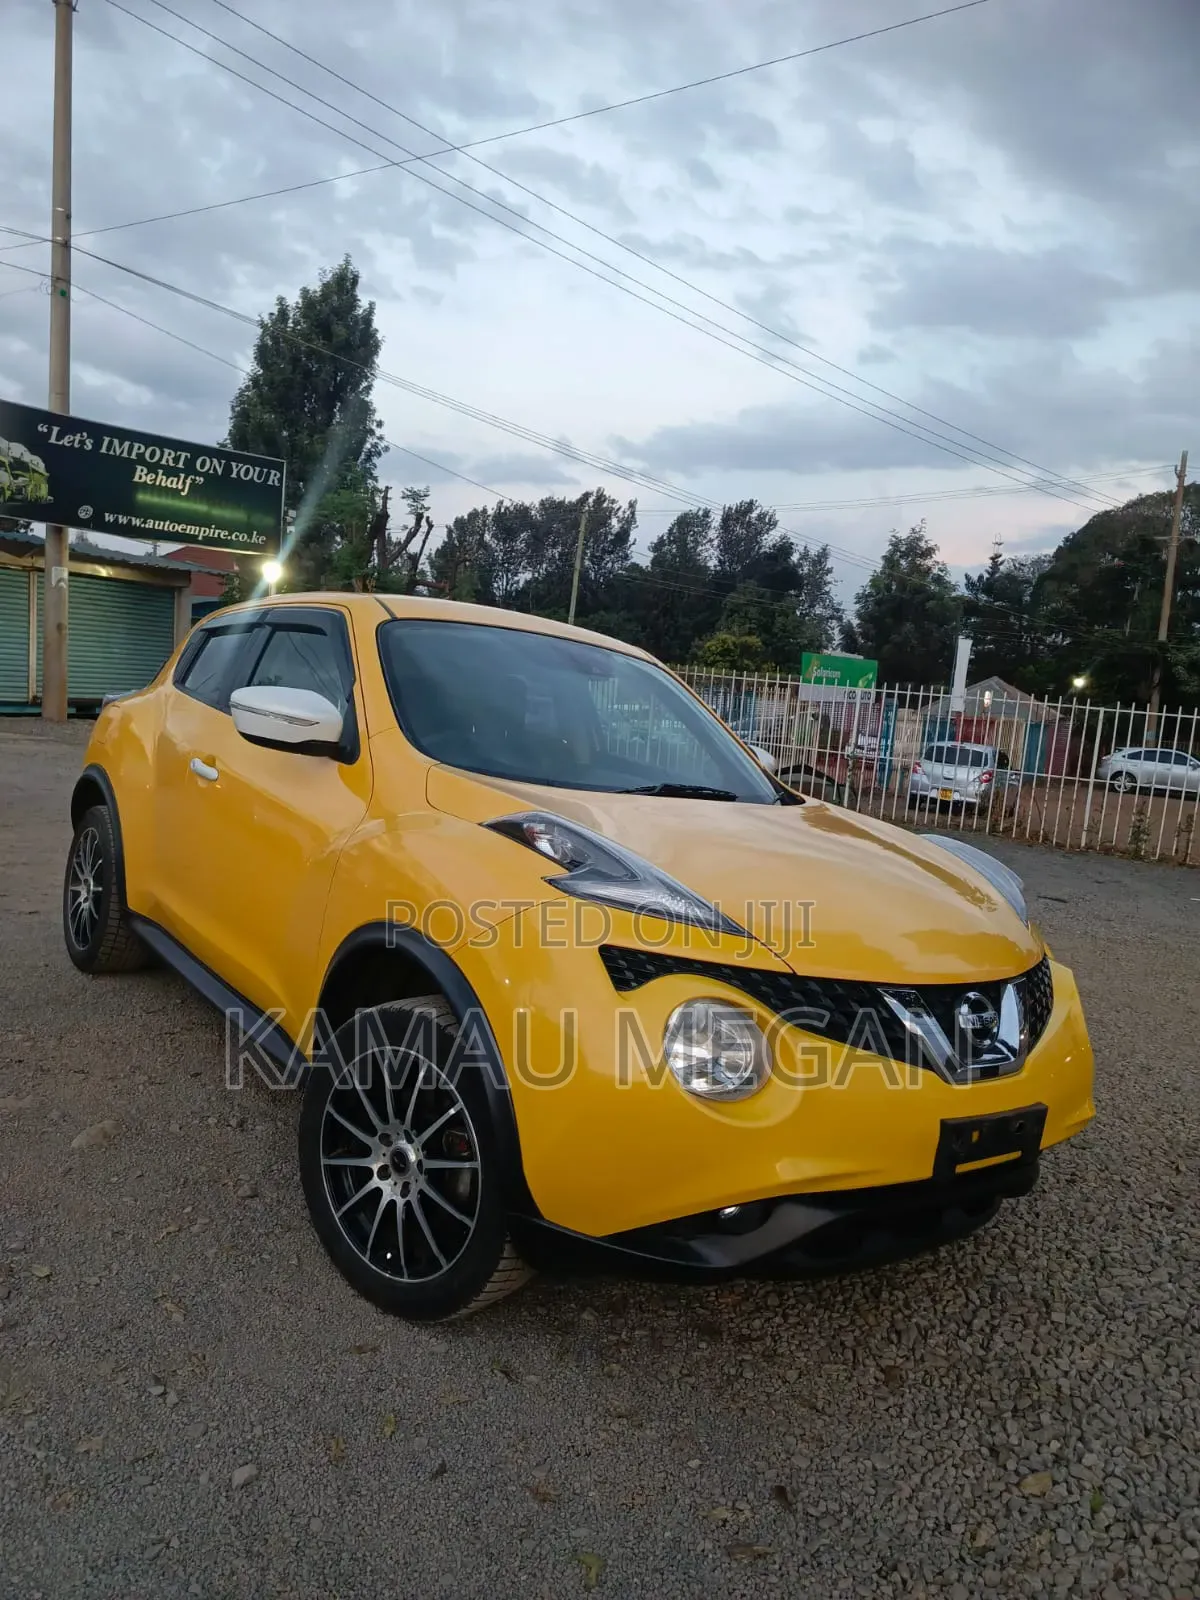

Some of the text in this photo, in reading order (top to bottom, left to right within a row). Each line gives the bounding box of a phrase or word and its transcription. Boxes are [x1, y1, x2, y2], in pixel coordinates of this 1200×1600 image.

[37, 423, 281, 487] “Let’s IMPORT ON YOUR
[132, 465, 204, 496] Behalf”
[104, 511, 267, 545] www.autoempire.co.ke
